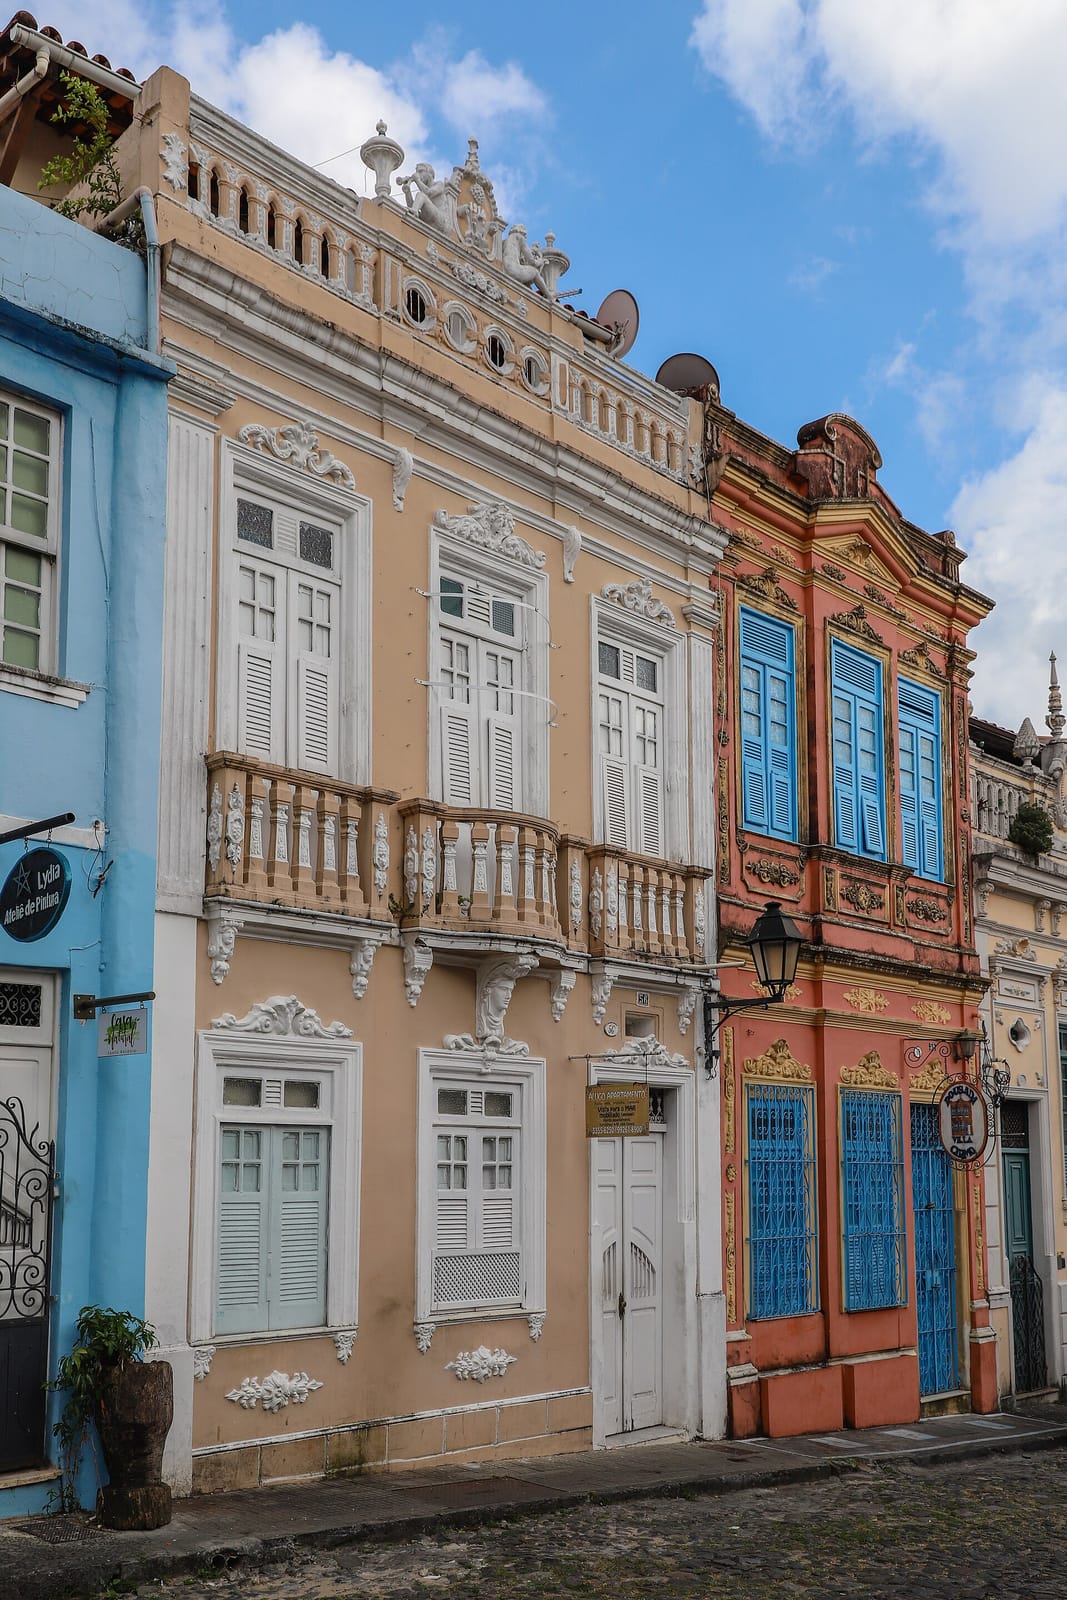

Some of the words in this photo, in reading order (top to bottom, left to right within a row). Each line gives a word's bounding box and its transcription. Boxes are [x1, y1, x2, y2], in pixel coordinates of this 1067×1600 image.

[37, 863, 61, 890] Lydia
[25, 898, 36, 916] de
[36, 891, 60, 912] Pintura
[111, 1013, 133, 1030] Casa
[589, 1091, 606, 1101] ALUGO
[606, 1090, 646, 1100] APARTAMENTO
[952, 1136, 973, 1144] VILLA
